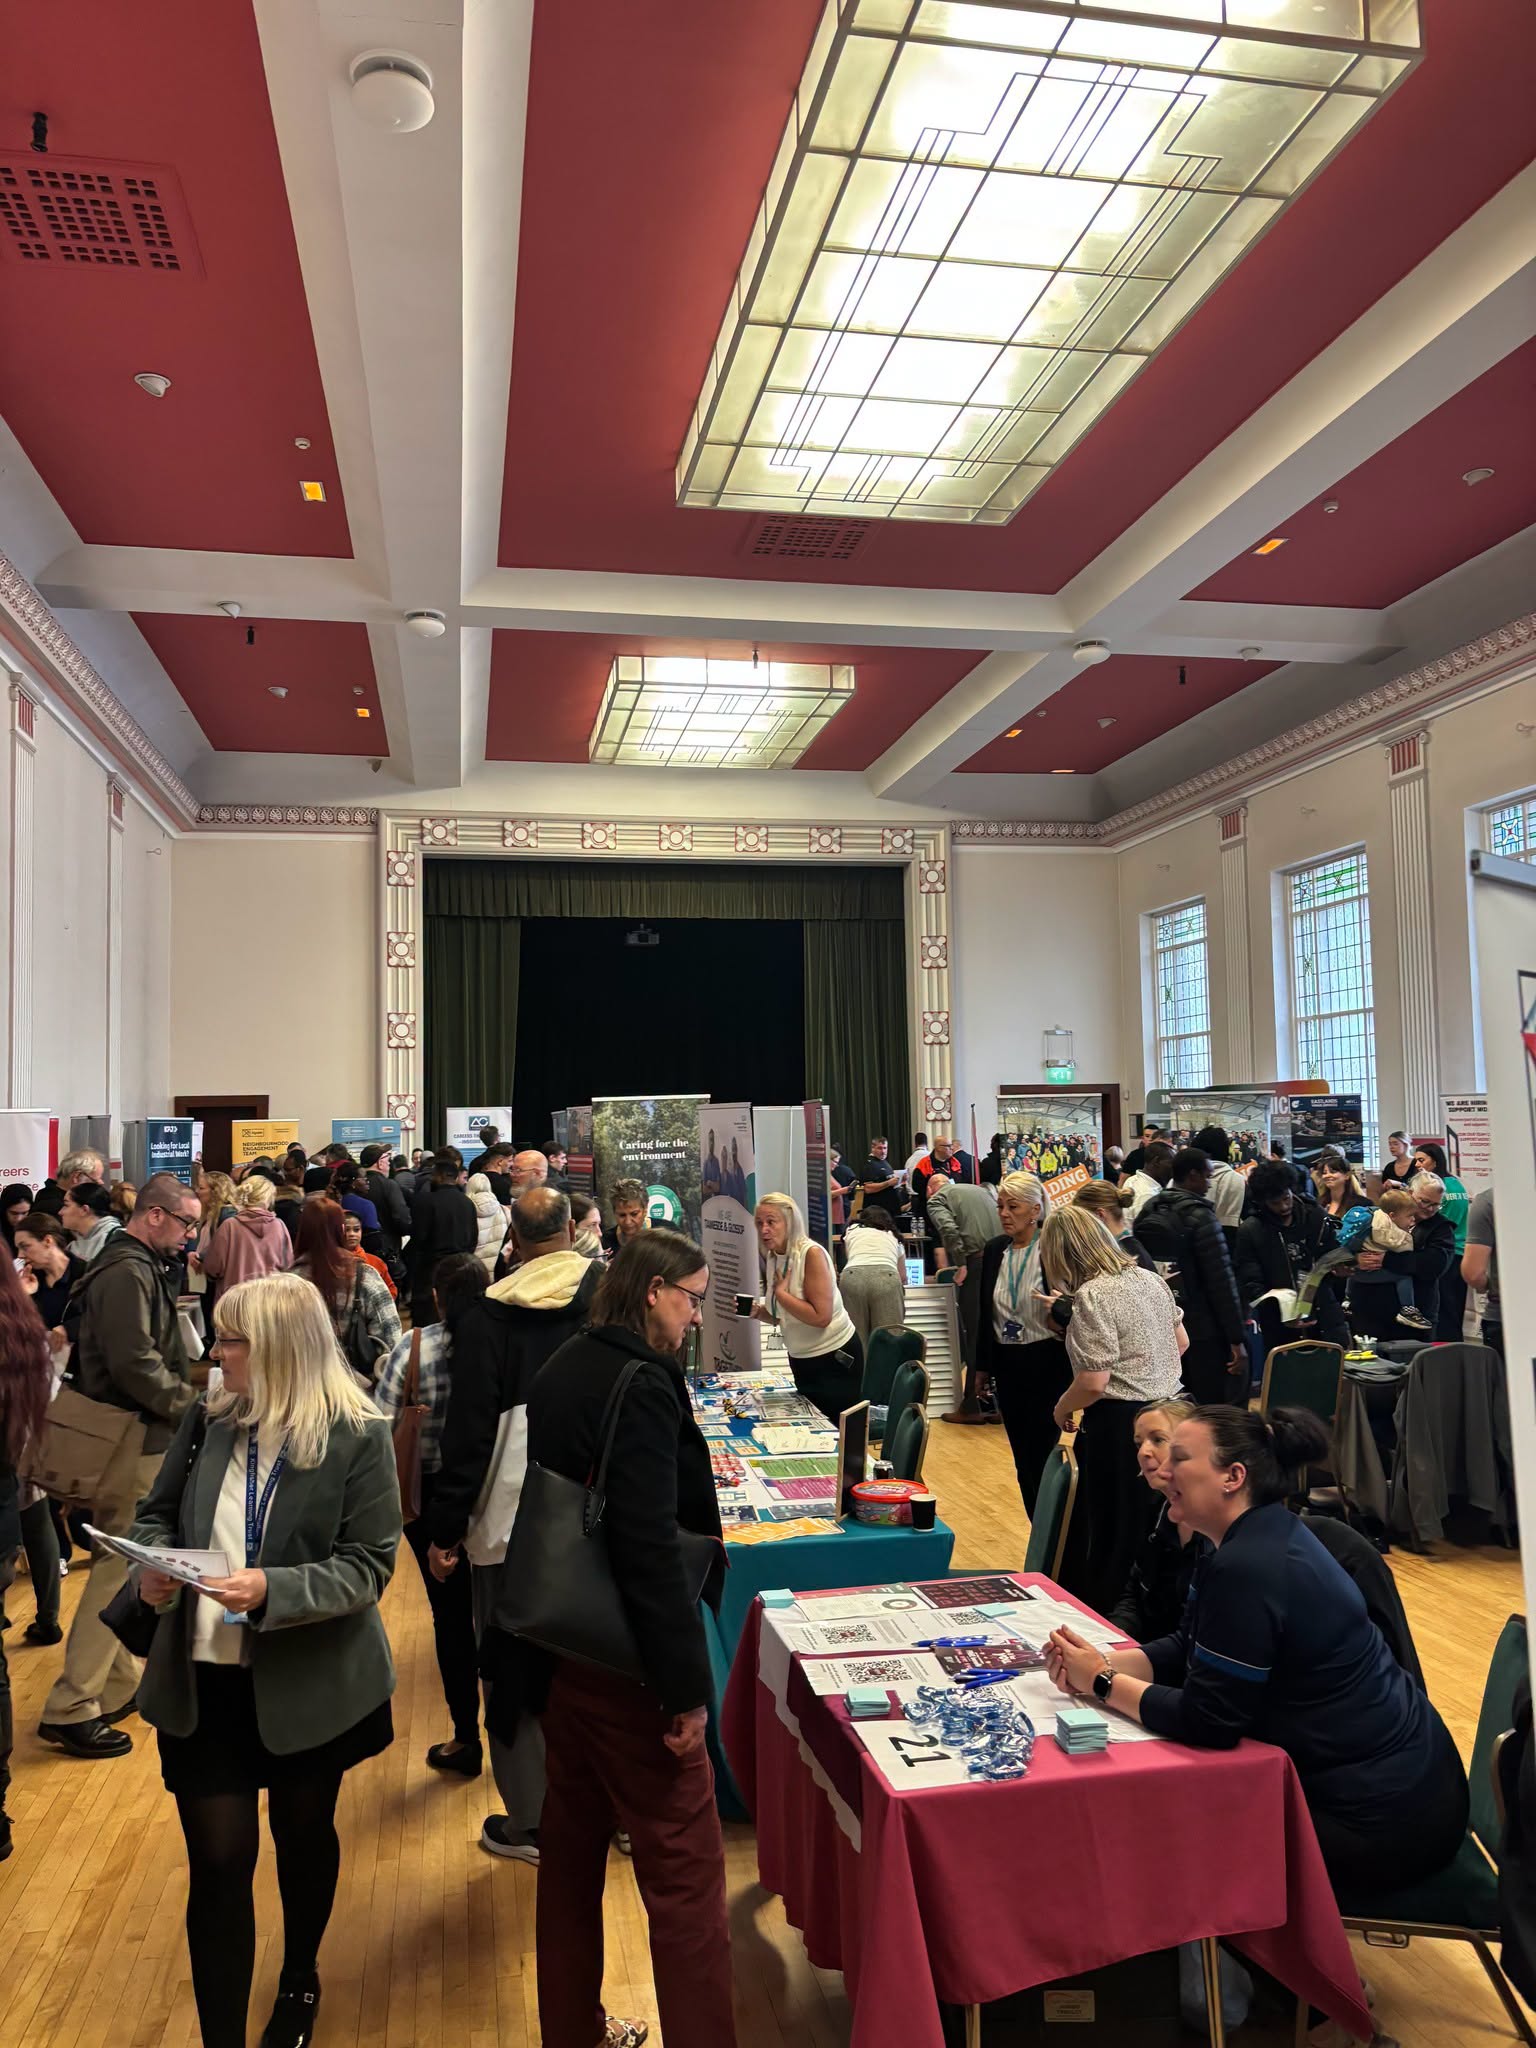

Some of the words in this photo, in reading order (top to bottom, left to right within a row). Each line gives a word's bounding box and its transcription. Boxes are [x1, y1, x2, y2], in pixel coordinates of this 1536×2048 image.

[150, 1141, 171, 1151] Looking
[170, 1141, 178, 1149] for
[178, 1141, 190, 1149] Local
[619, 1140, 654, 1150] Caring
[655, 1139, 671, 1148] for
[672, 1138, 689, 1147] the
[151, 1150, 175, 1158] Industrial
[175, 1150, 190, 1158] Work?
[622, 1151, 686, 1161] environment
[1048, 1168, 1087, 1196] DING
[888, 1734, 952, 1768] 21
